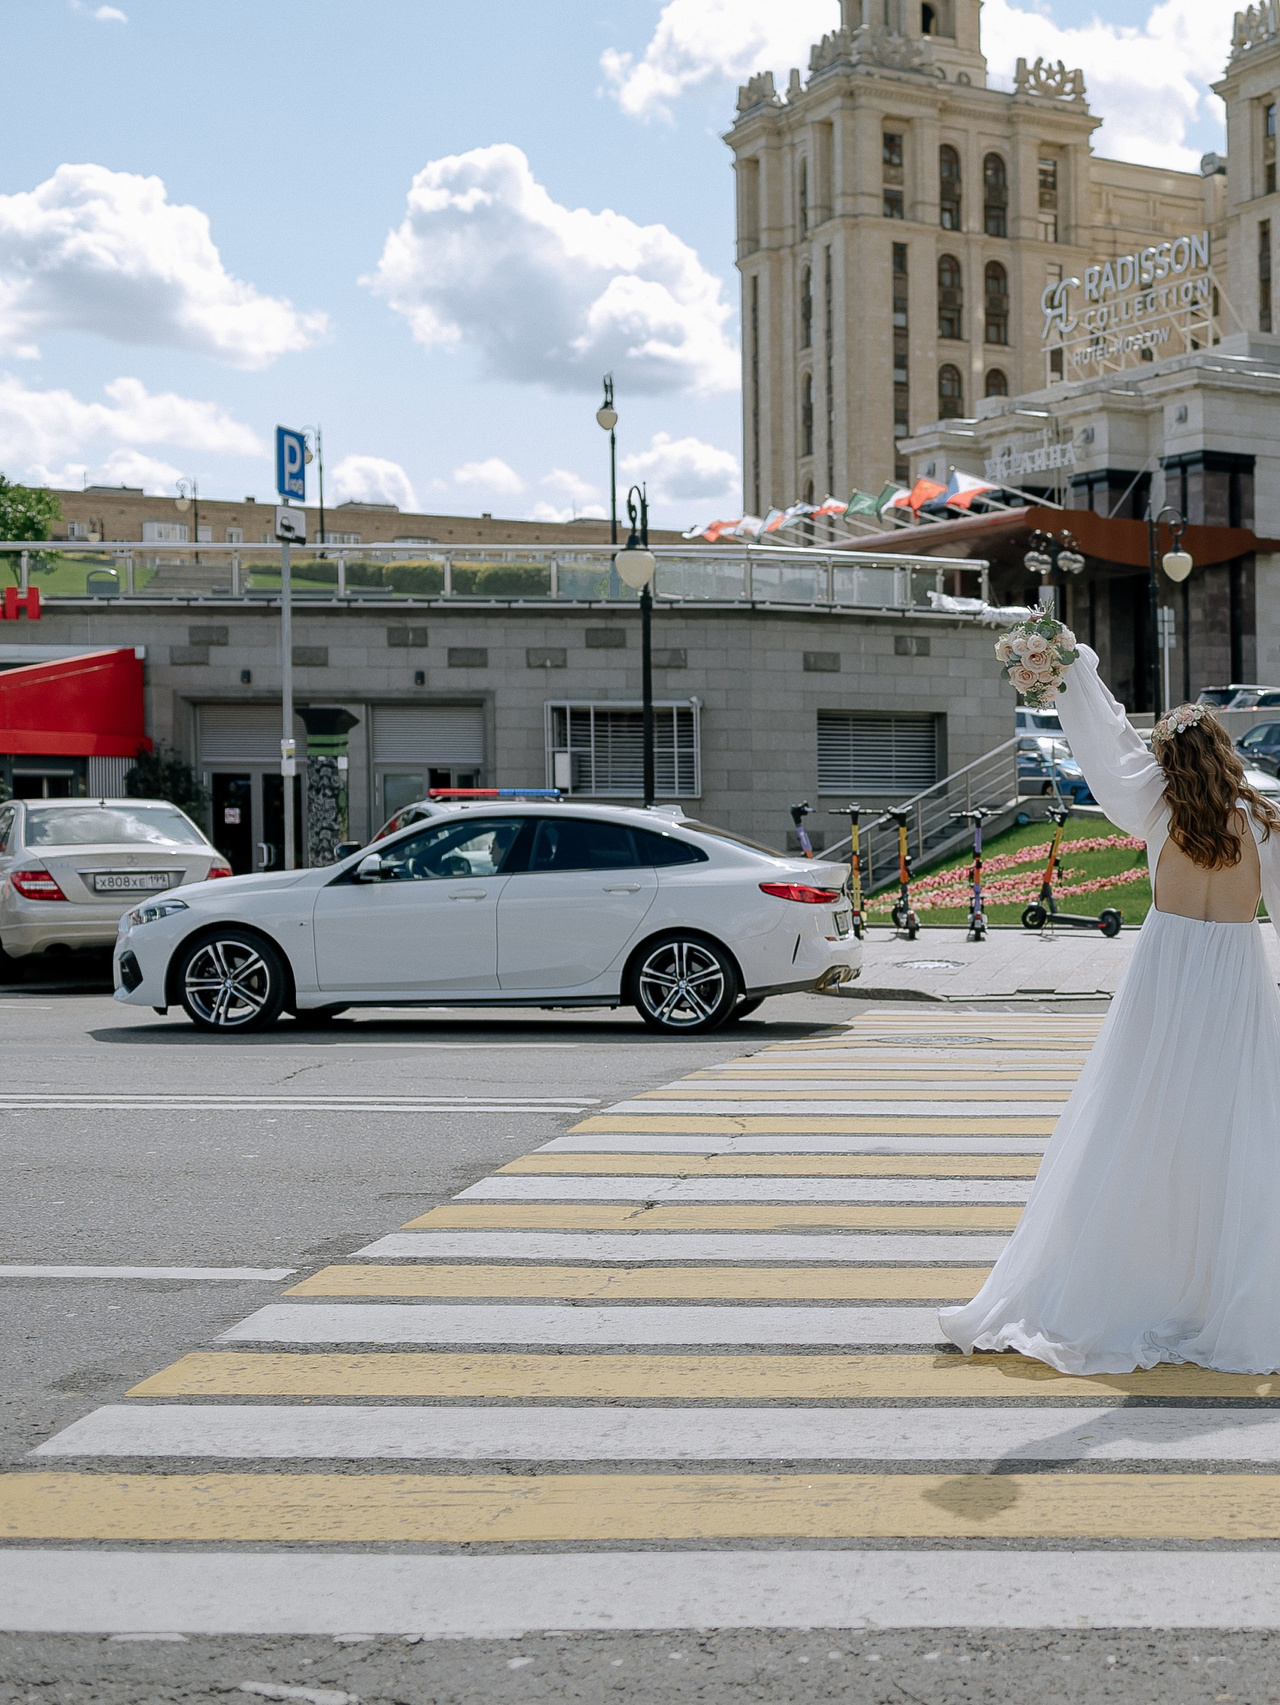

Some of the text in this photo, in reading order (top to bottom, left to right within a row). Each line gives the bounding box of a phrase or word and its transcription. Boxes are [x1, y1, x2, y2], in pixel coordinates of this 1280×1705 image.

[1084, 230, 1210, 300] RADISSON
[1084, 278, 1209, 330] COLLECTION
[1114, 326, 1171, 355] MOSCOW
[984, 442, 1076, 481] УКРАИНА
